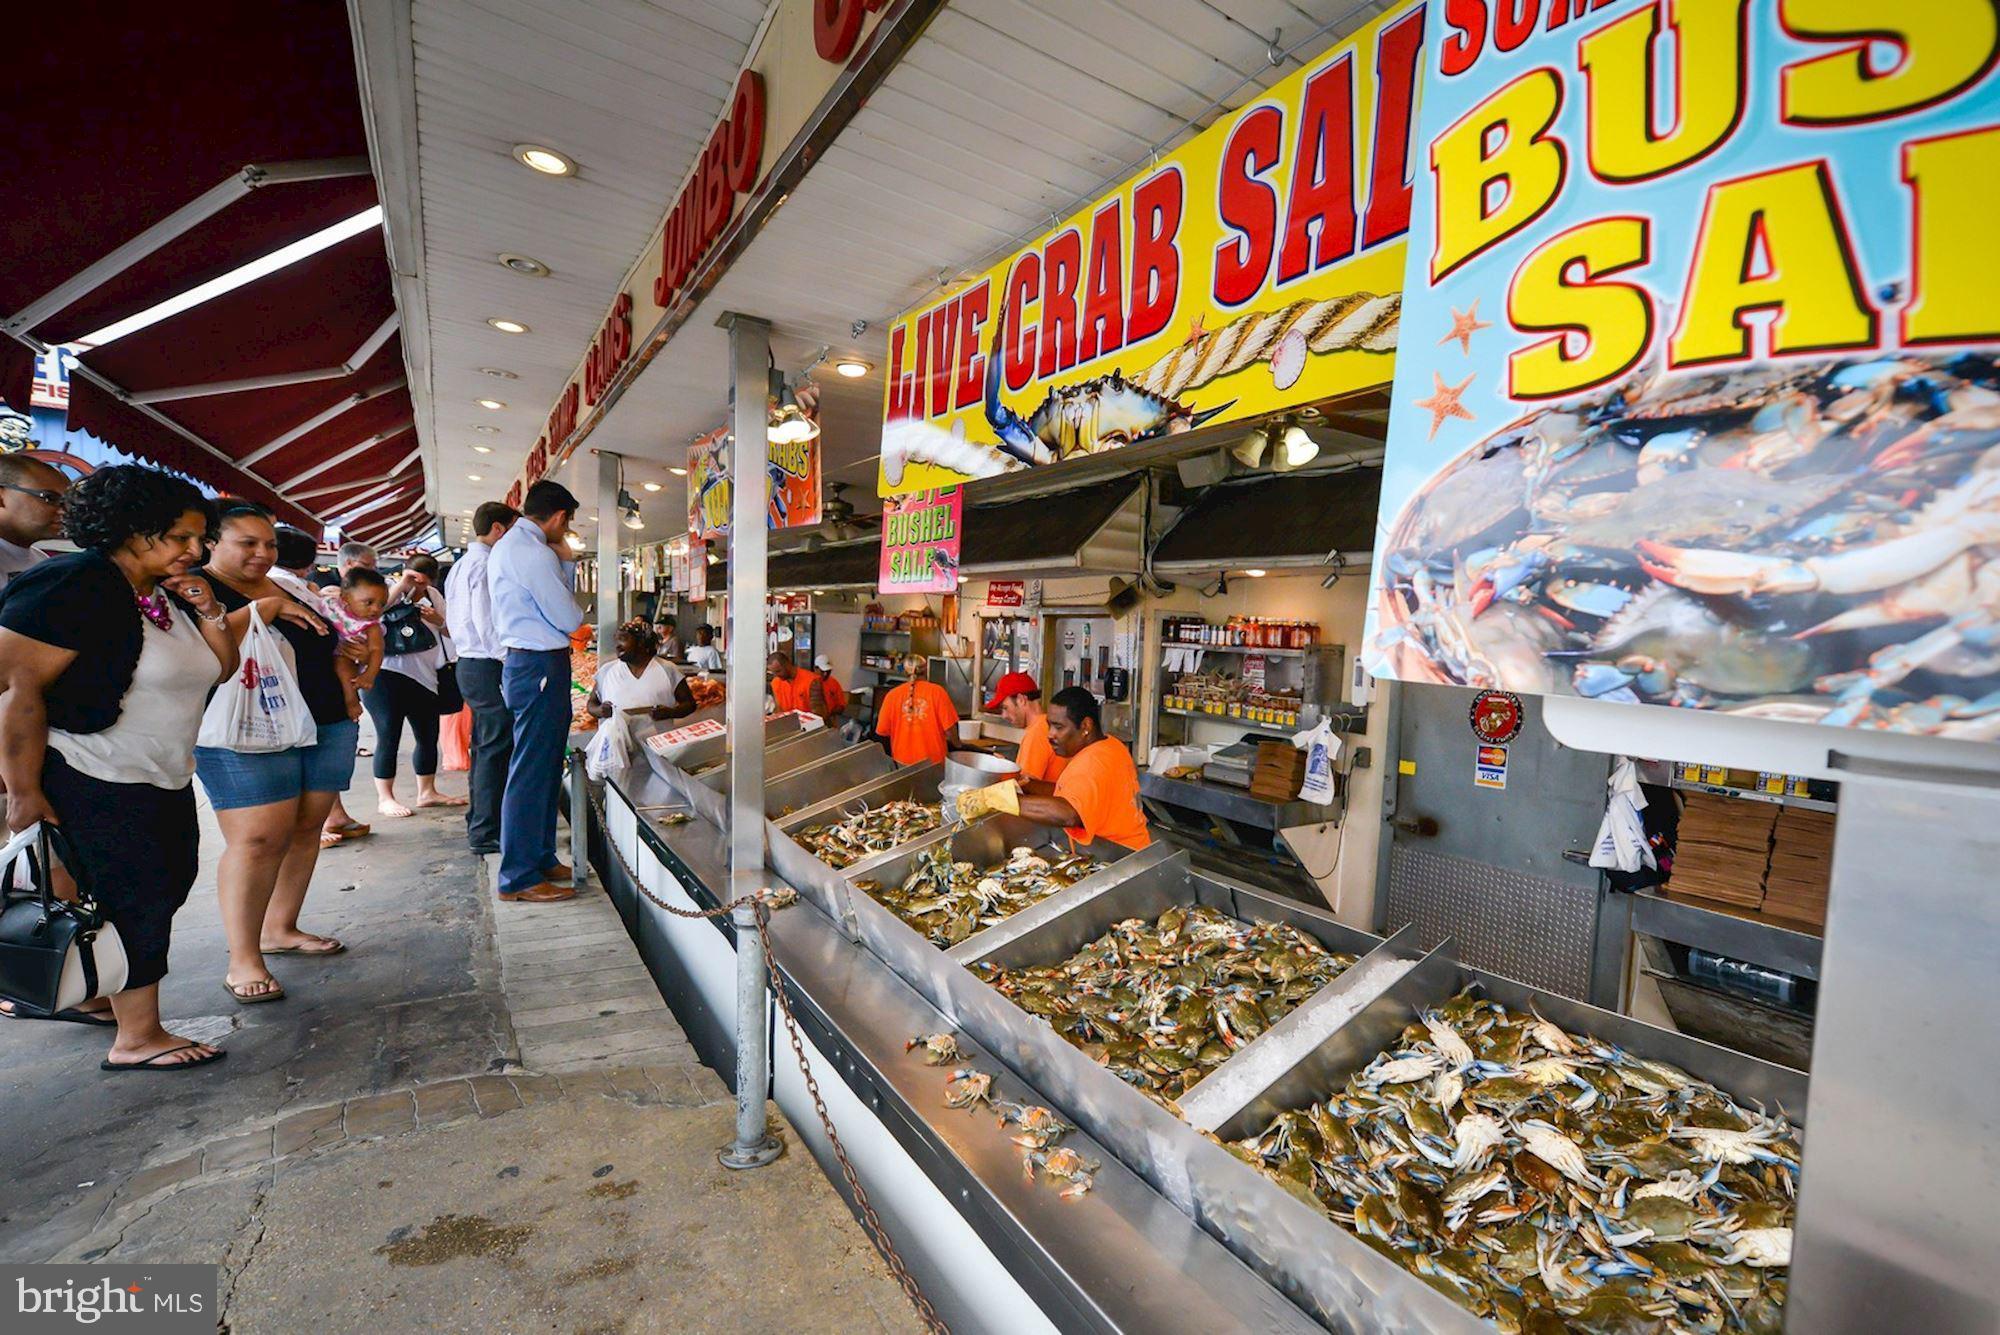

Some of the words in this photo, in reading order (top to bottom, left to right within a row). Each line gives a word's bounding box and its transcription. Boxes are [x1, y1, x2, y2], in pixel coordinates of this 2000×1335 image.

[654, 67, 765, 308] JUMBO
[888, 280, 990, 424] LIVE
[1003, 167, 1184, 392] CRAB
[886, 504, 955, 547] BUSHEL
[890, 547, 936, 584] SALE
[1481, 772, 1500, 781] VISA
